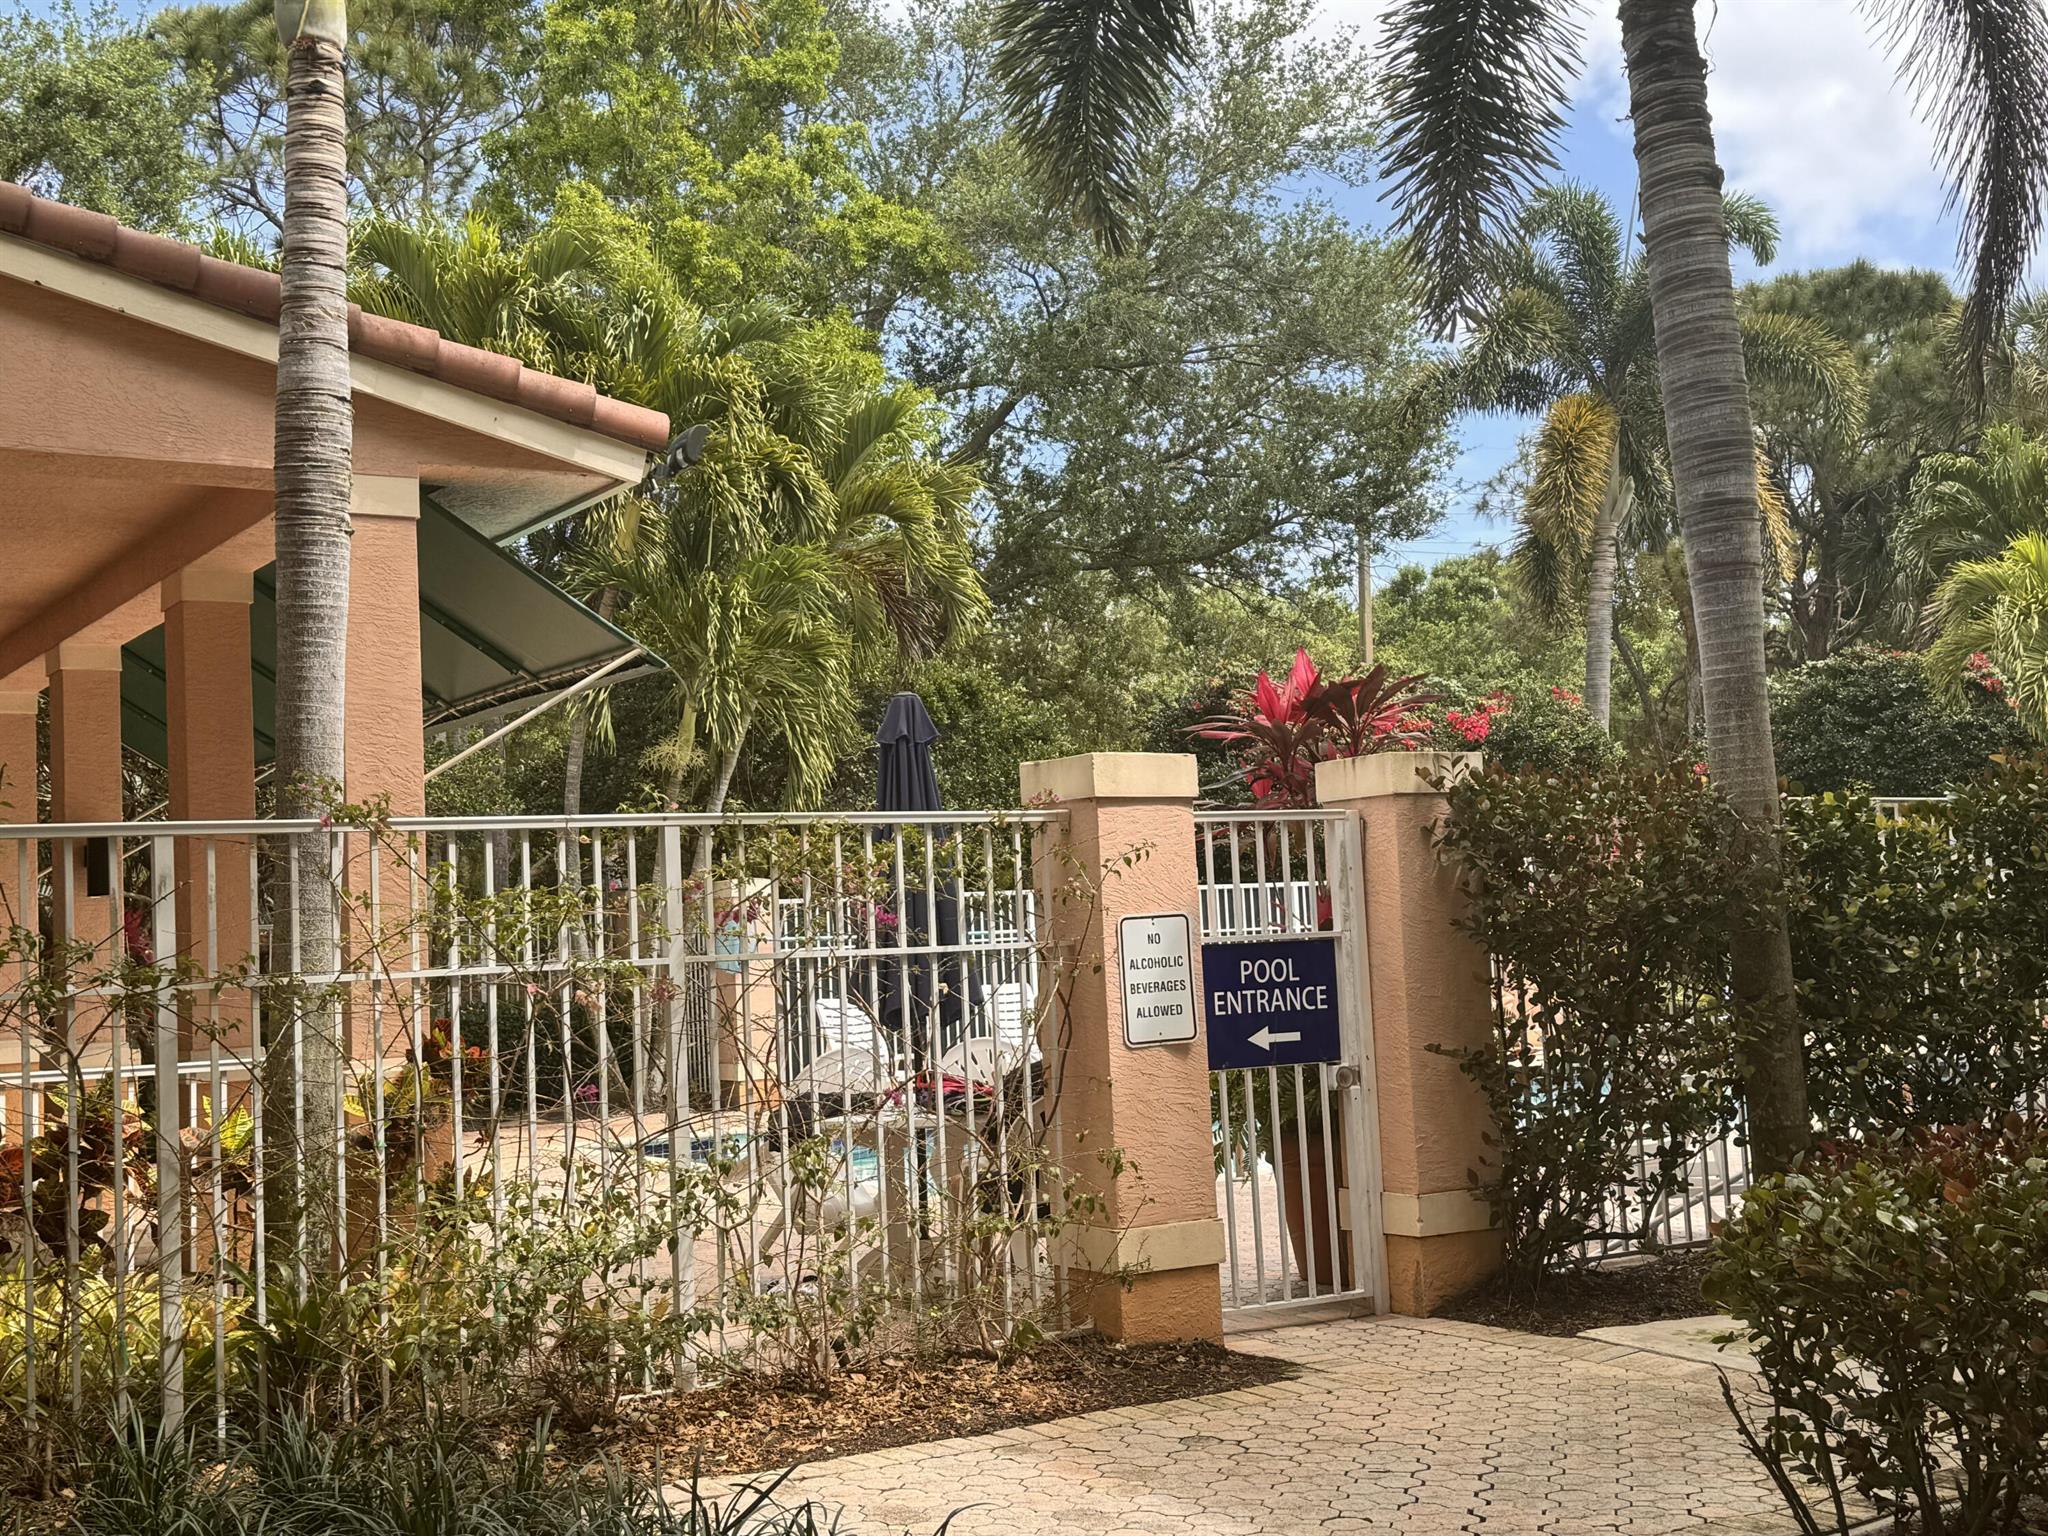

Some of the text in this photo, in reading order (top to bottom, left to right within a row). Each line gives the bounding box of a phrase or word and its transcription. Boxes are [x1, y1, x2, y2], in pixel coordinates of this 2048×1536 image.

[1147, 933, 1161, 945] NO
[1129, 955, 1184, 971] ALCOHOLIC
[1240, 958, 1300, 984] POOL
[1130, 979, 1186, 995] BEVERAGES
[1214, 985, 1328, 1016] ENTRANCE
[1136, 1003, 1183, 1019] ALLOWED
